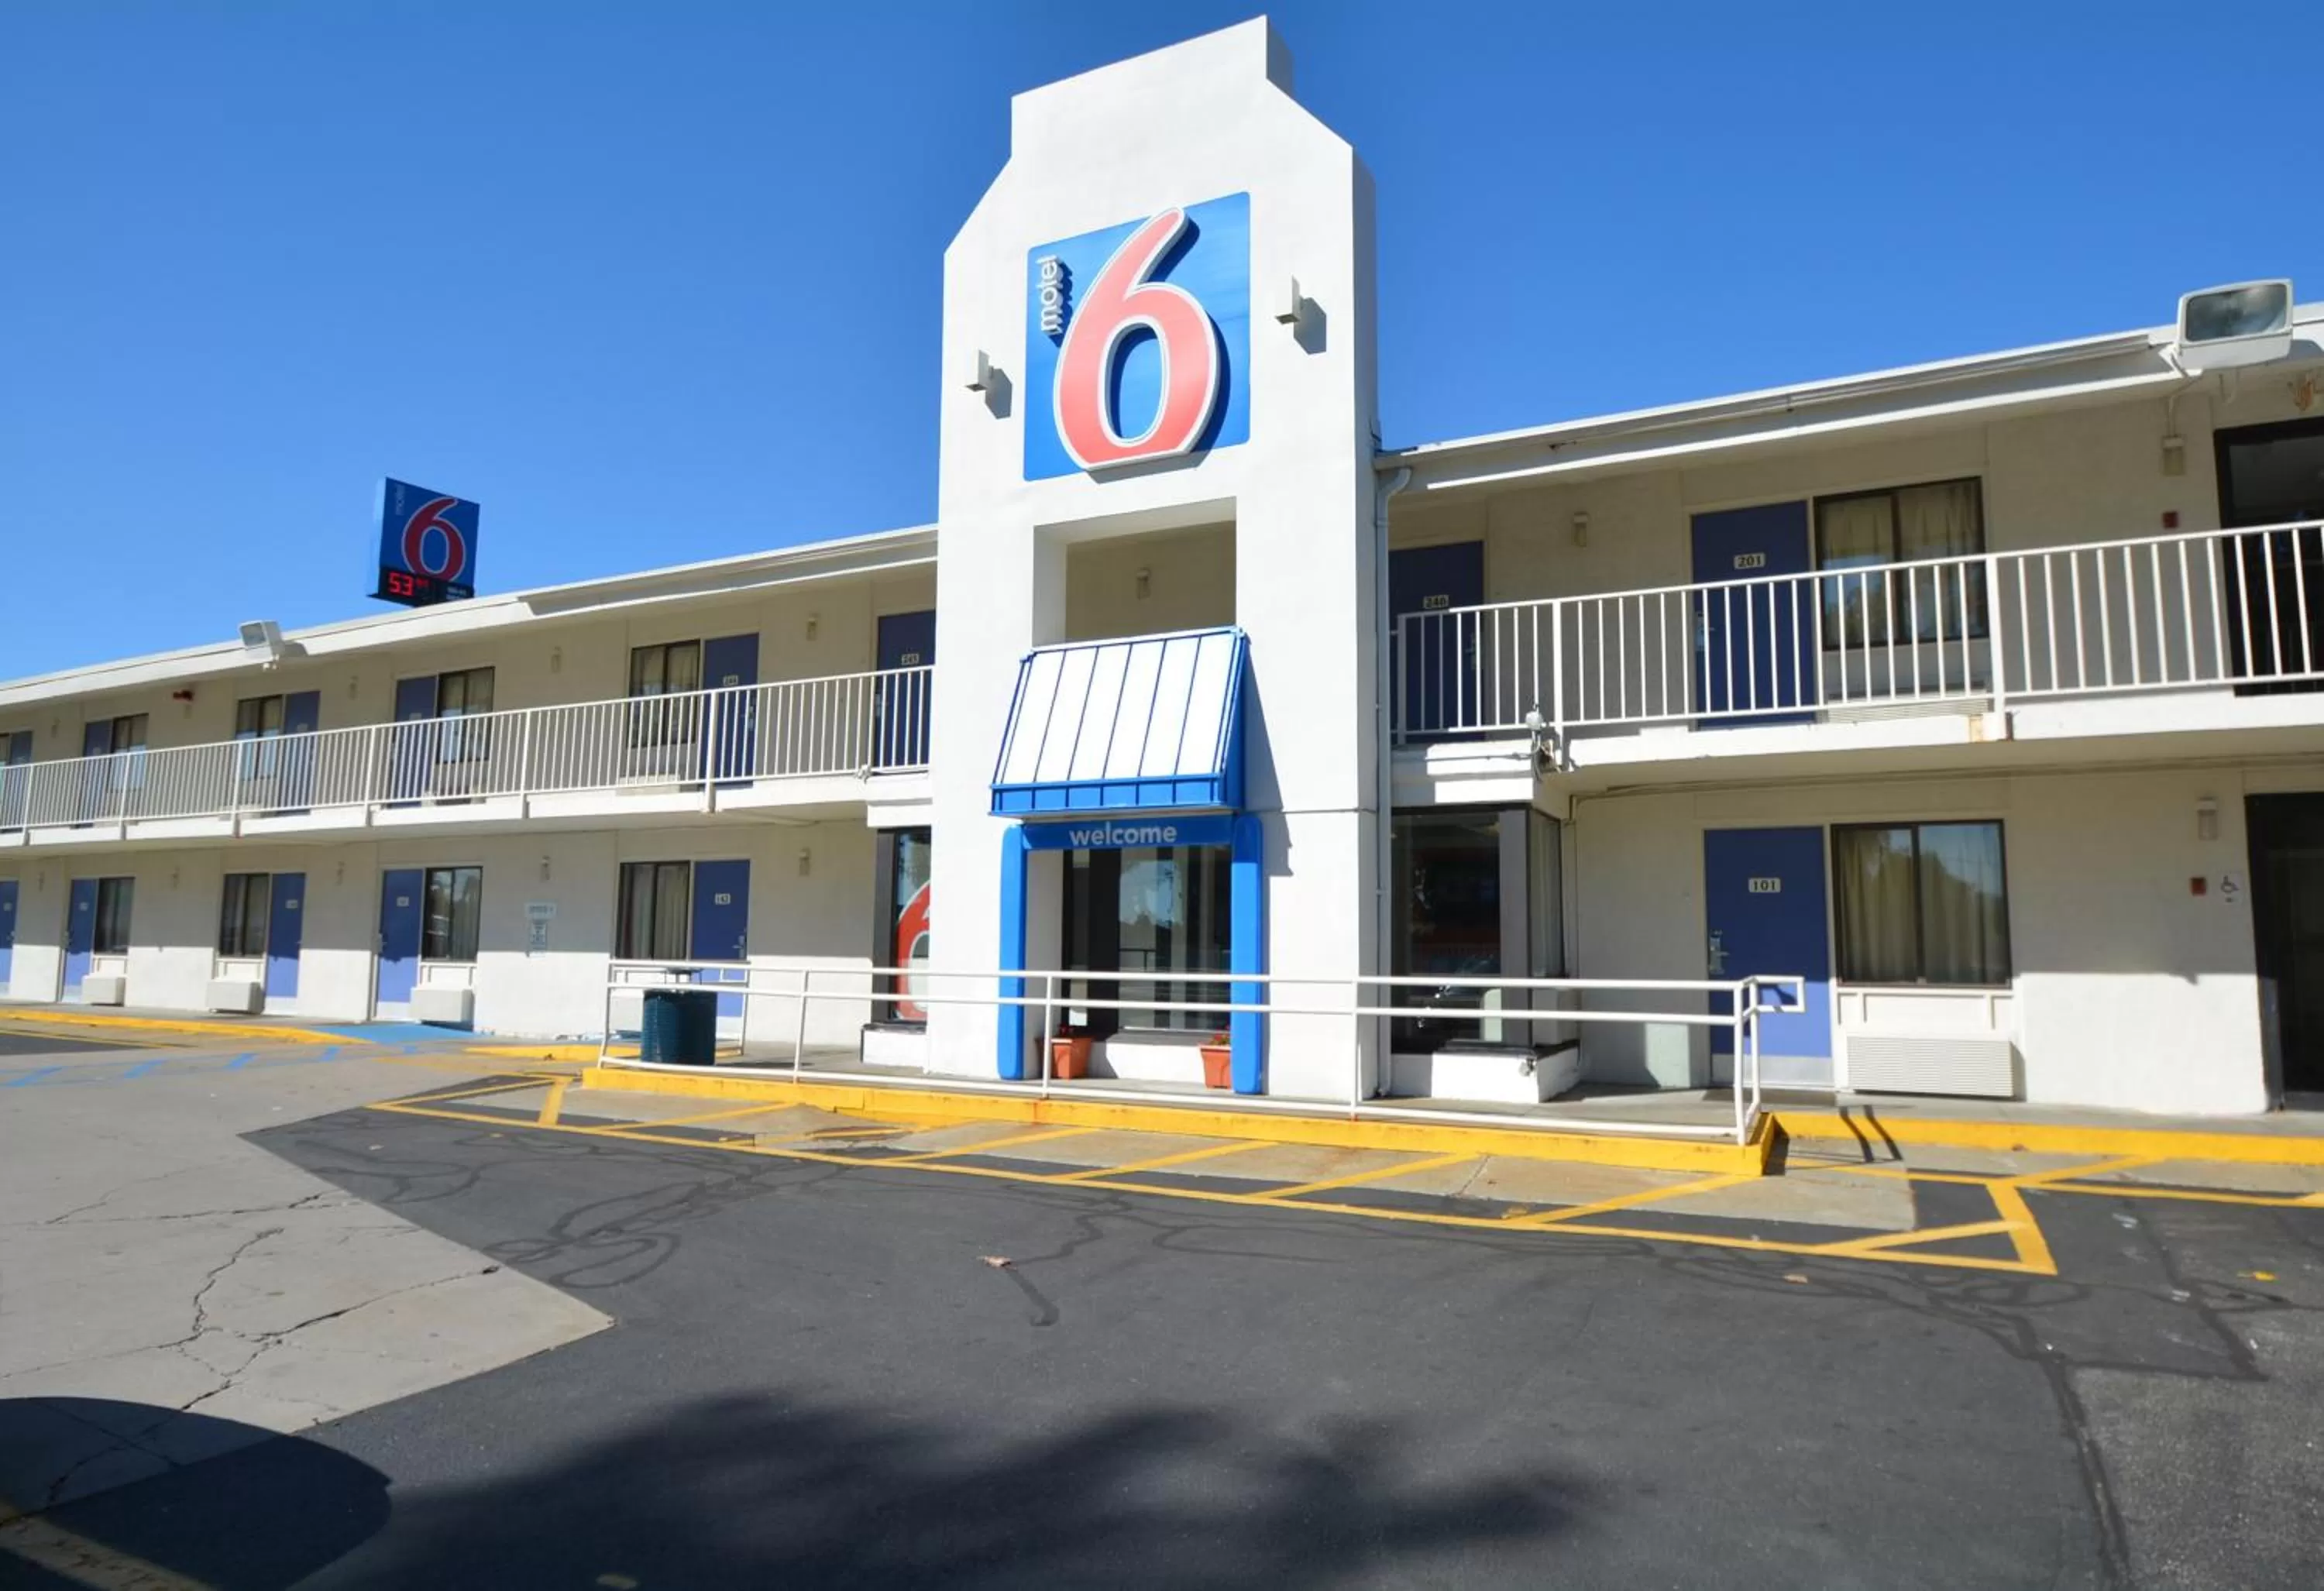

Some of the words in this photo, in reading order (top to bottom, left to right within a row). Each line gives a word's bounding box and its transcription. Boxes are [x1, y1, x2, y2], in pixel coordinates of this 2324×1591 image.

[1036, 256, 1061, 333] motel
[1053, 205, 1220, 477] 6
[401, 496, 466, 582] 6
[1737, 555, 1762, 567] 201
[389, 571, 414, 596] 53
[1068, 821, 1177, 846] welcome
[1753, 879, 1776, 892] 101
